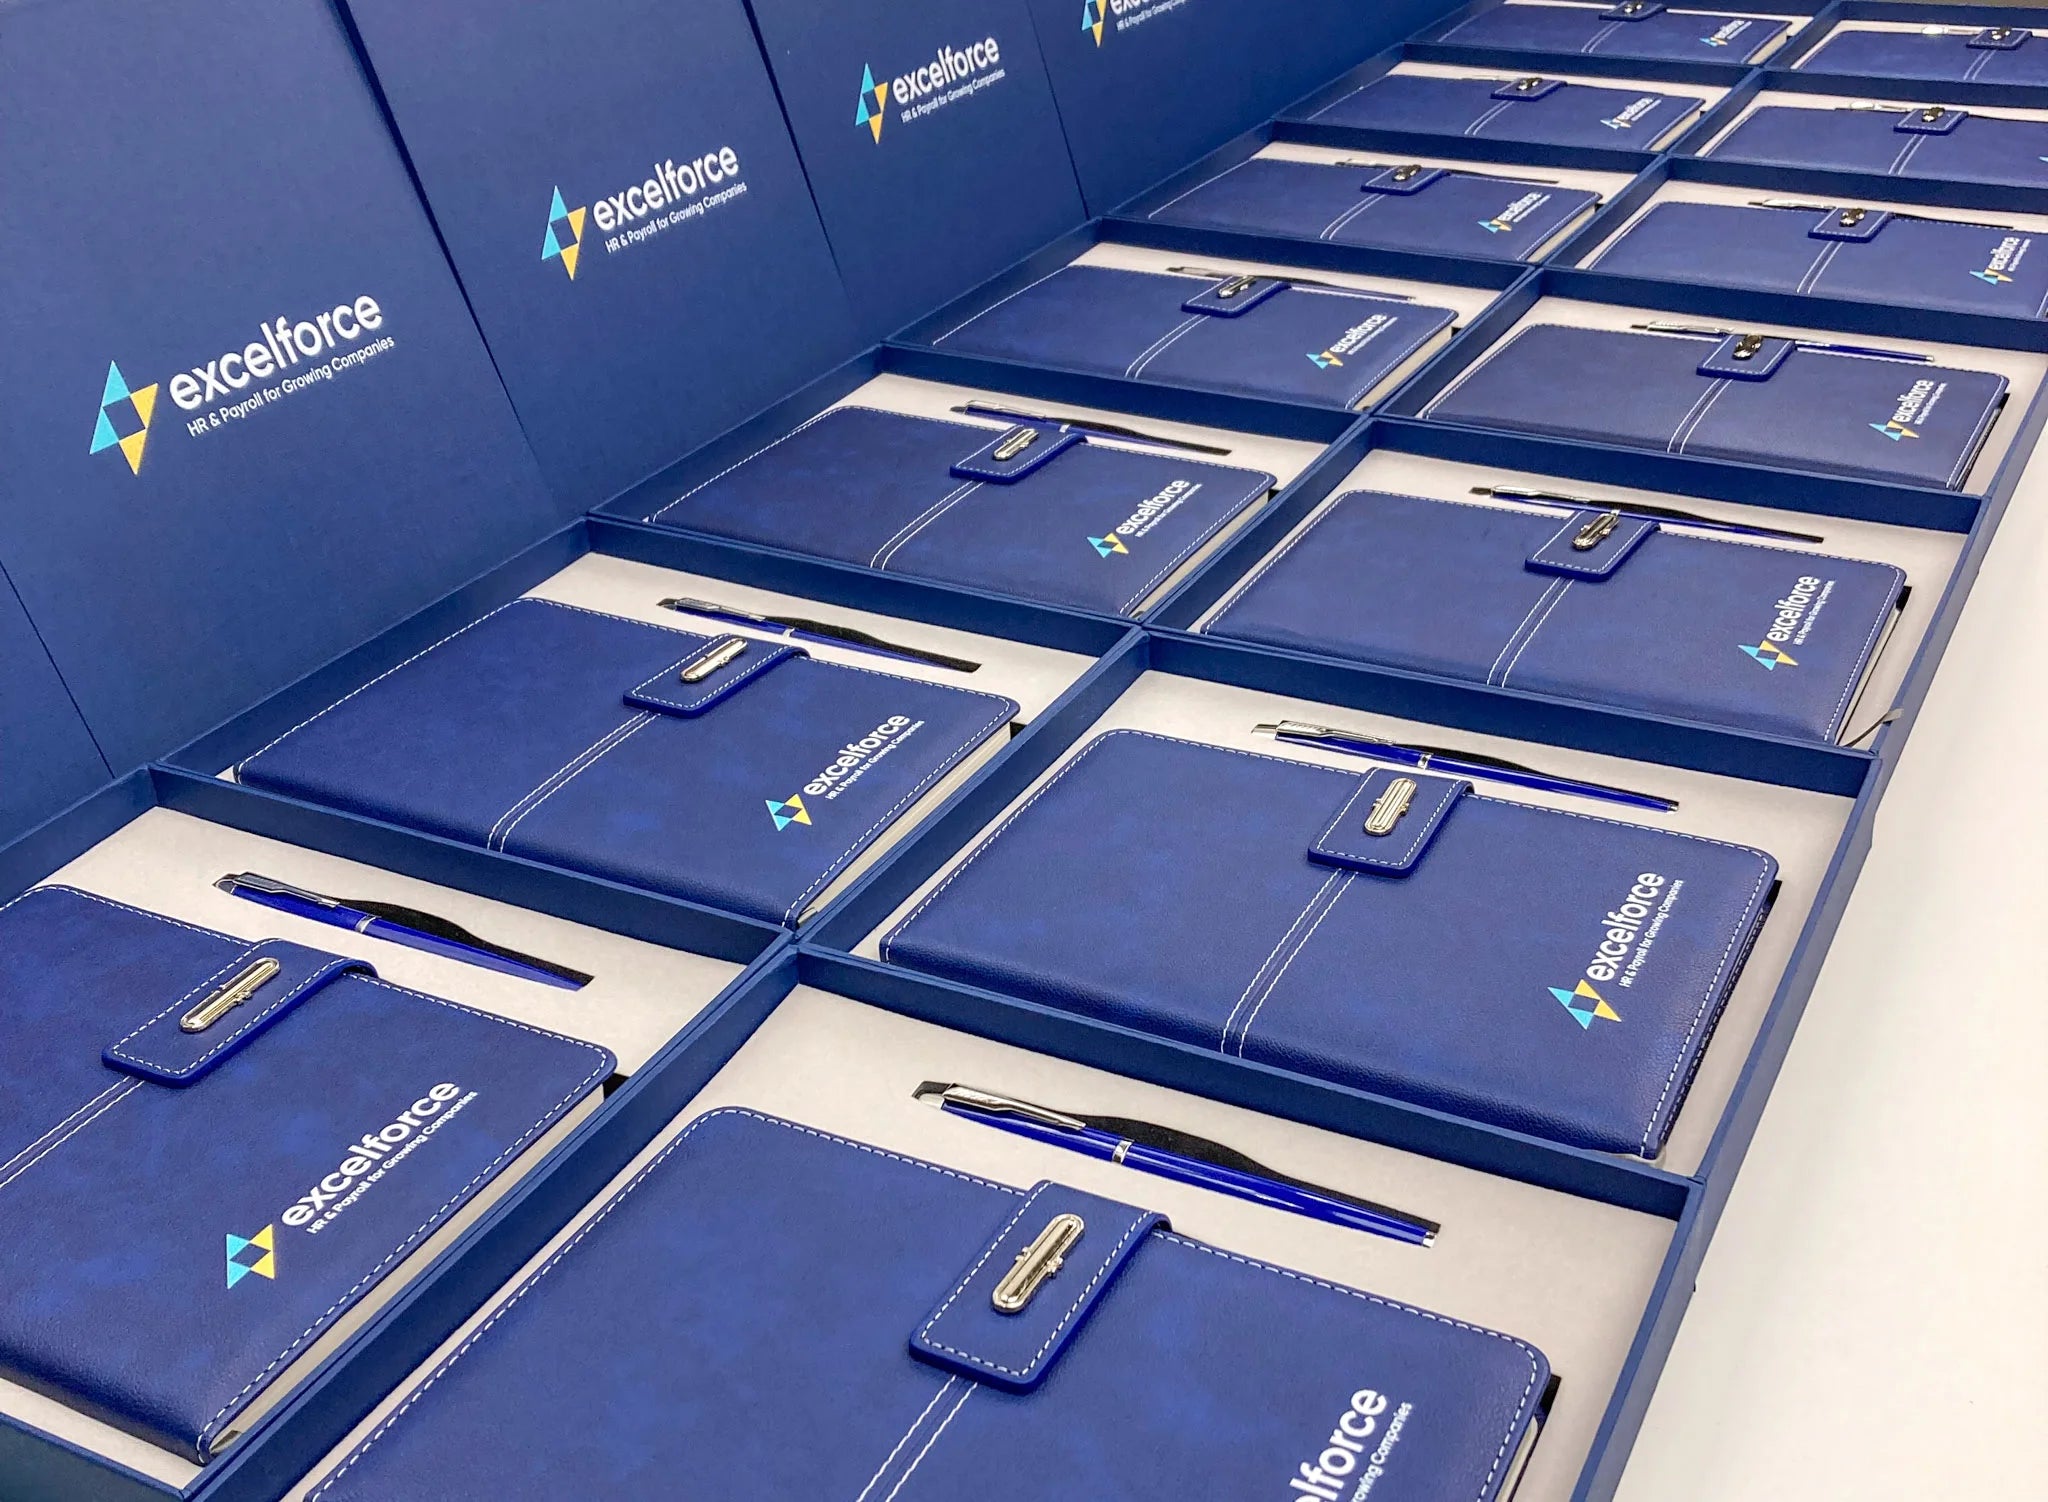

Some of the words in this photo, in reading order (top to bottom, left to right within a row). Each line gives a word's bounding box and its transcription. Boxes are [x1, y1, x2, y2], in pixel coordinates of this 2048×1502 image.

[892, 37, 1000, 104] excelforce
[593, 146, 739, 231] excelforce
[605, 238, 620, 254] HR
[619, 234, 629, 247] &
[627, 220, 658, 244] Payroll
[655, 216, 670, 231] for
[669, 201, 705, 224] Growing
[702, 182, 748, 208] Companies
[169, 295, 383, 410] excelforce
[186, 416, 209, 437] HR
[208, 411, 221, 427] &
[219, 394, 265, 421] Payroll
[262, 386, 282, 403] for
[281, 364, 333, 393] Growing
[330, 336, 395, 371] Companies
[1115, 480, 1190, 535] excelforce
[1766, 576, 1821, 642] excelforce
[803, 715, 910, 796] excelforce
[825, 790, 840, 800] HR
[839, 770, 864, 787] Payroll
[867, 744, 897, 763] Growing
[1586, 872, 1665, 981] excelforce
[1644, 912, 1670, 939] Growing
[1657, 879, 1684, 912] Companies
[1627, 947, 1648, 971] Payroll
[1638, 937, 1654, 949] for
[1618, 975, 1634, 988] HR
[281, 1082, 460, 1226] excelforce
[306, 1216, 329, 1234] HR
[323, 1211, 338, 1221] &
[332, 1180, 373, 1213] Payroll
[367, 1169, 386, 1183] for
[382, 1133, 428, 1169] Growing
[422, 1091, 478, 1135] Companies
[1288, 1389, 1388, 1502] lforce
[1350, 1463, 1384, 1502] owing
[1370, 1401, 1413, 1465] Companies
